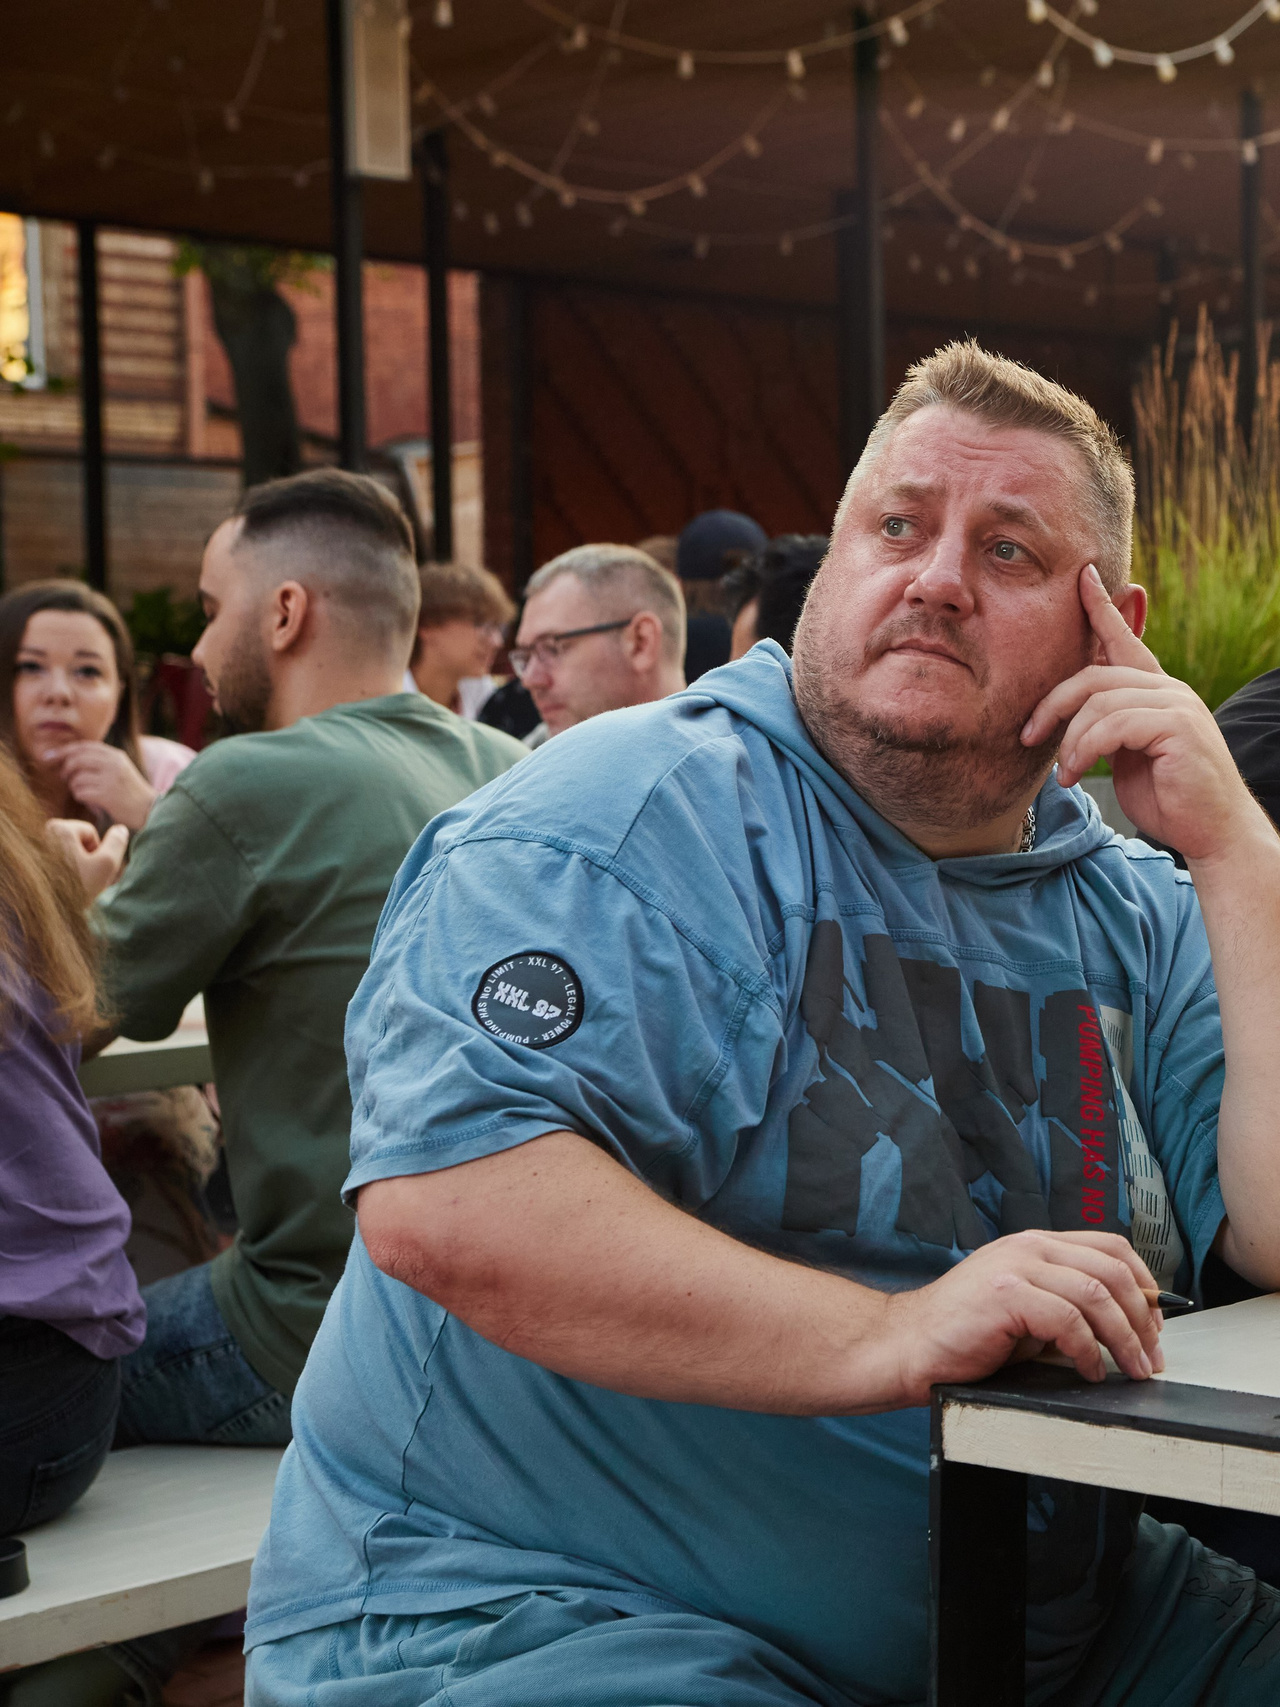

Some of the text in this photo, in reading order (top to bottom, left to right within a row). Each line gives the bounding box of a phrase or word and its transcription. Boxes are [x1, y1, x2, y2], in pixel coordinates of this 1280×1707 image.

[478, 957, 564, 1044] PUMPING HAS NO LIMIT XXL 97
[542, 983, 577, 1041] LEGAL POWER
[1076, 1004, 1106, 1225] PUMPING HAS NO
